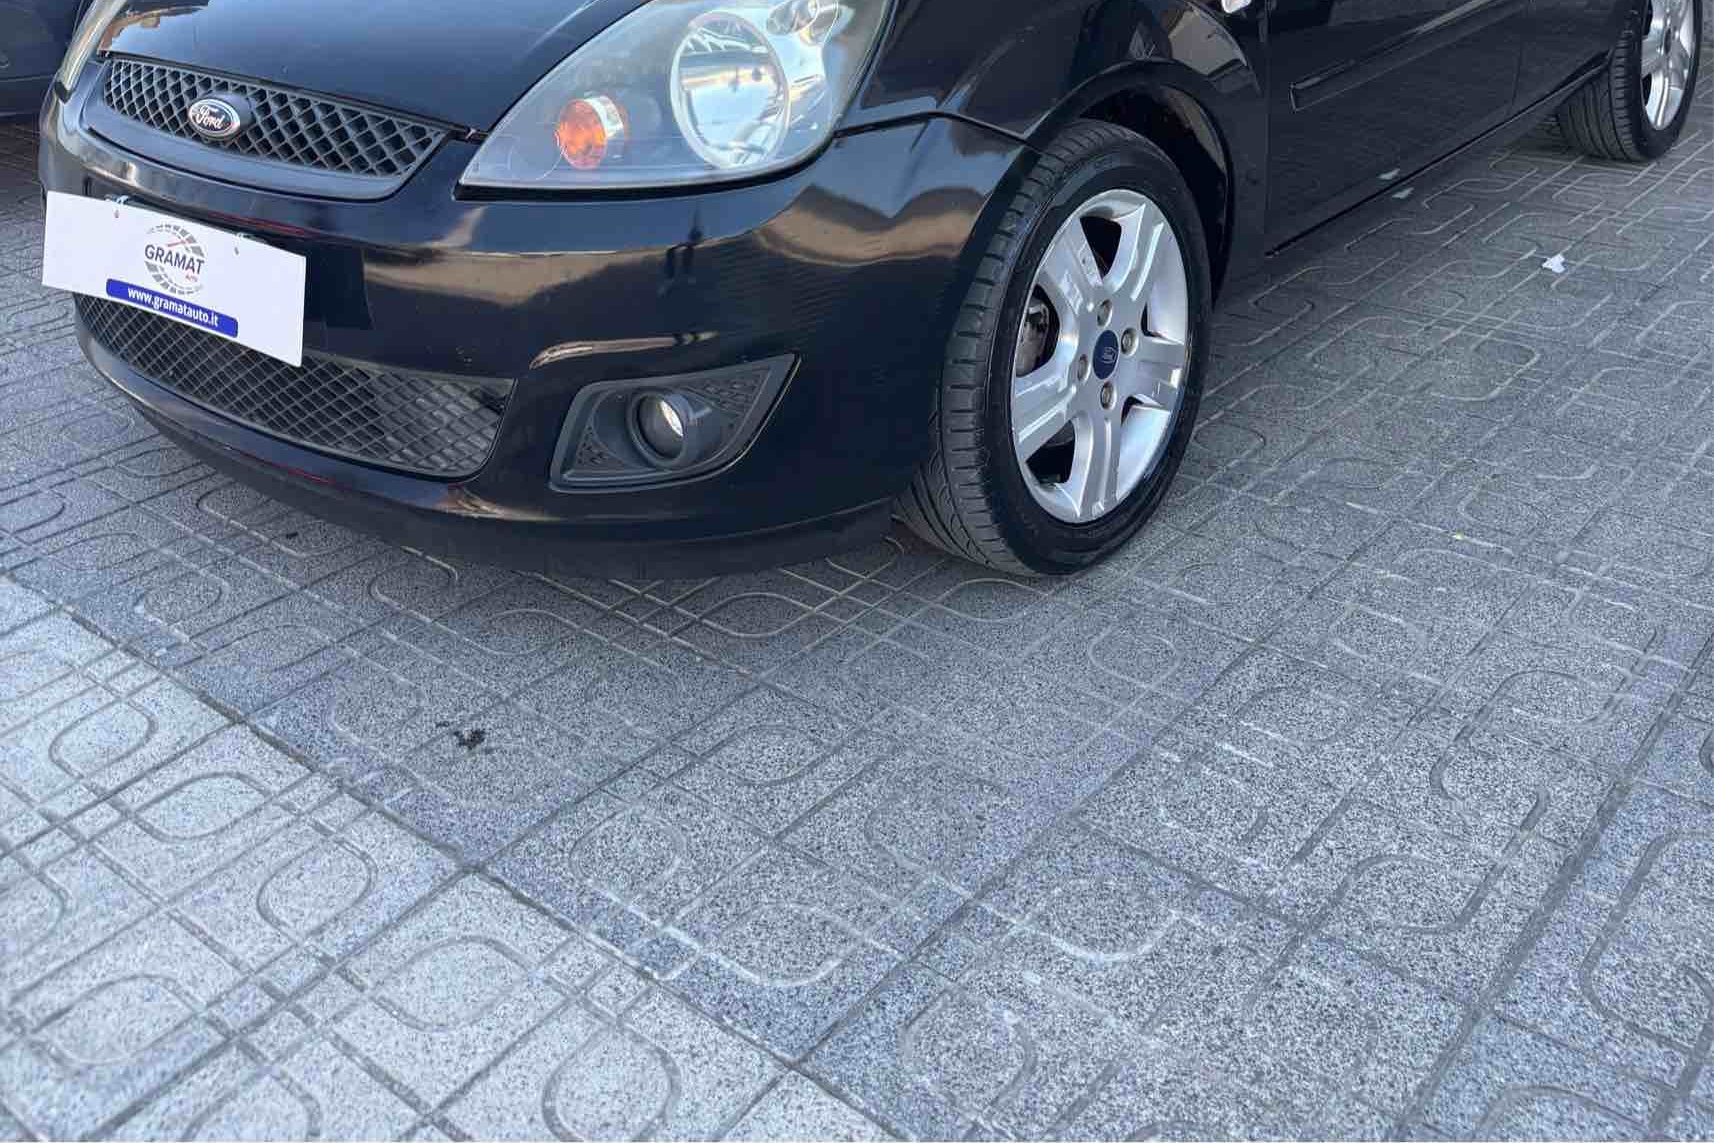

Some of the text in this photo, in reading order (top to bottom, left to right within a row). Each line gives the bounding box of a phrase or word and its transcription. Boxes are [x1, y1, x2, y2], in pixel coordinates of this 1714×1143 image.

[194, 104, 226, 129] Ford
[144, 244, 205, 274] GRAMAT
[127, 287, 219, 327] www.gramatauto.it
